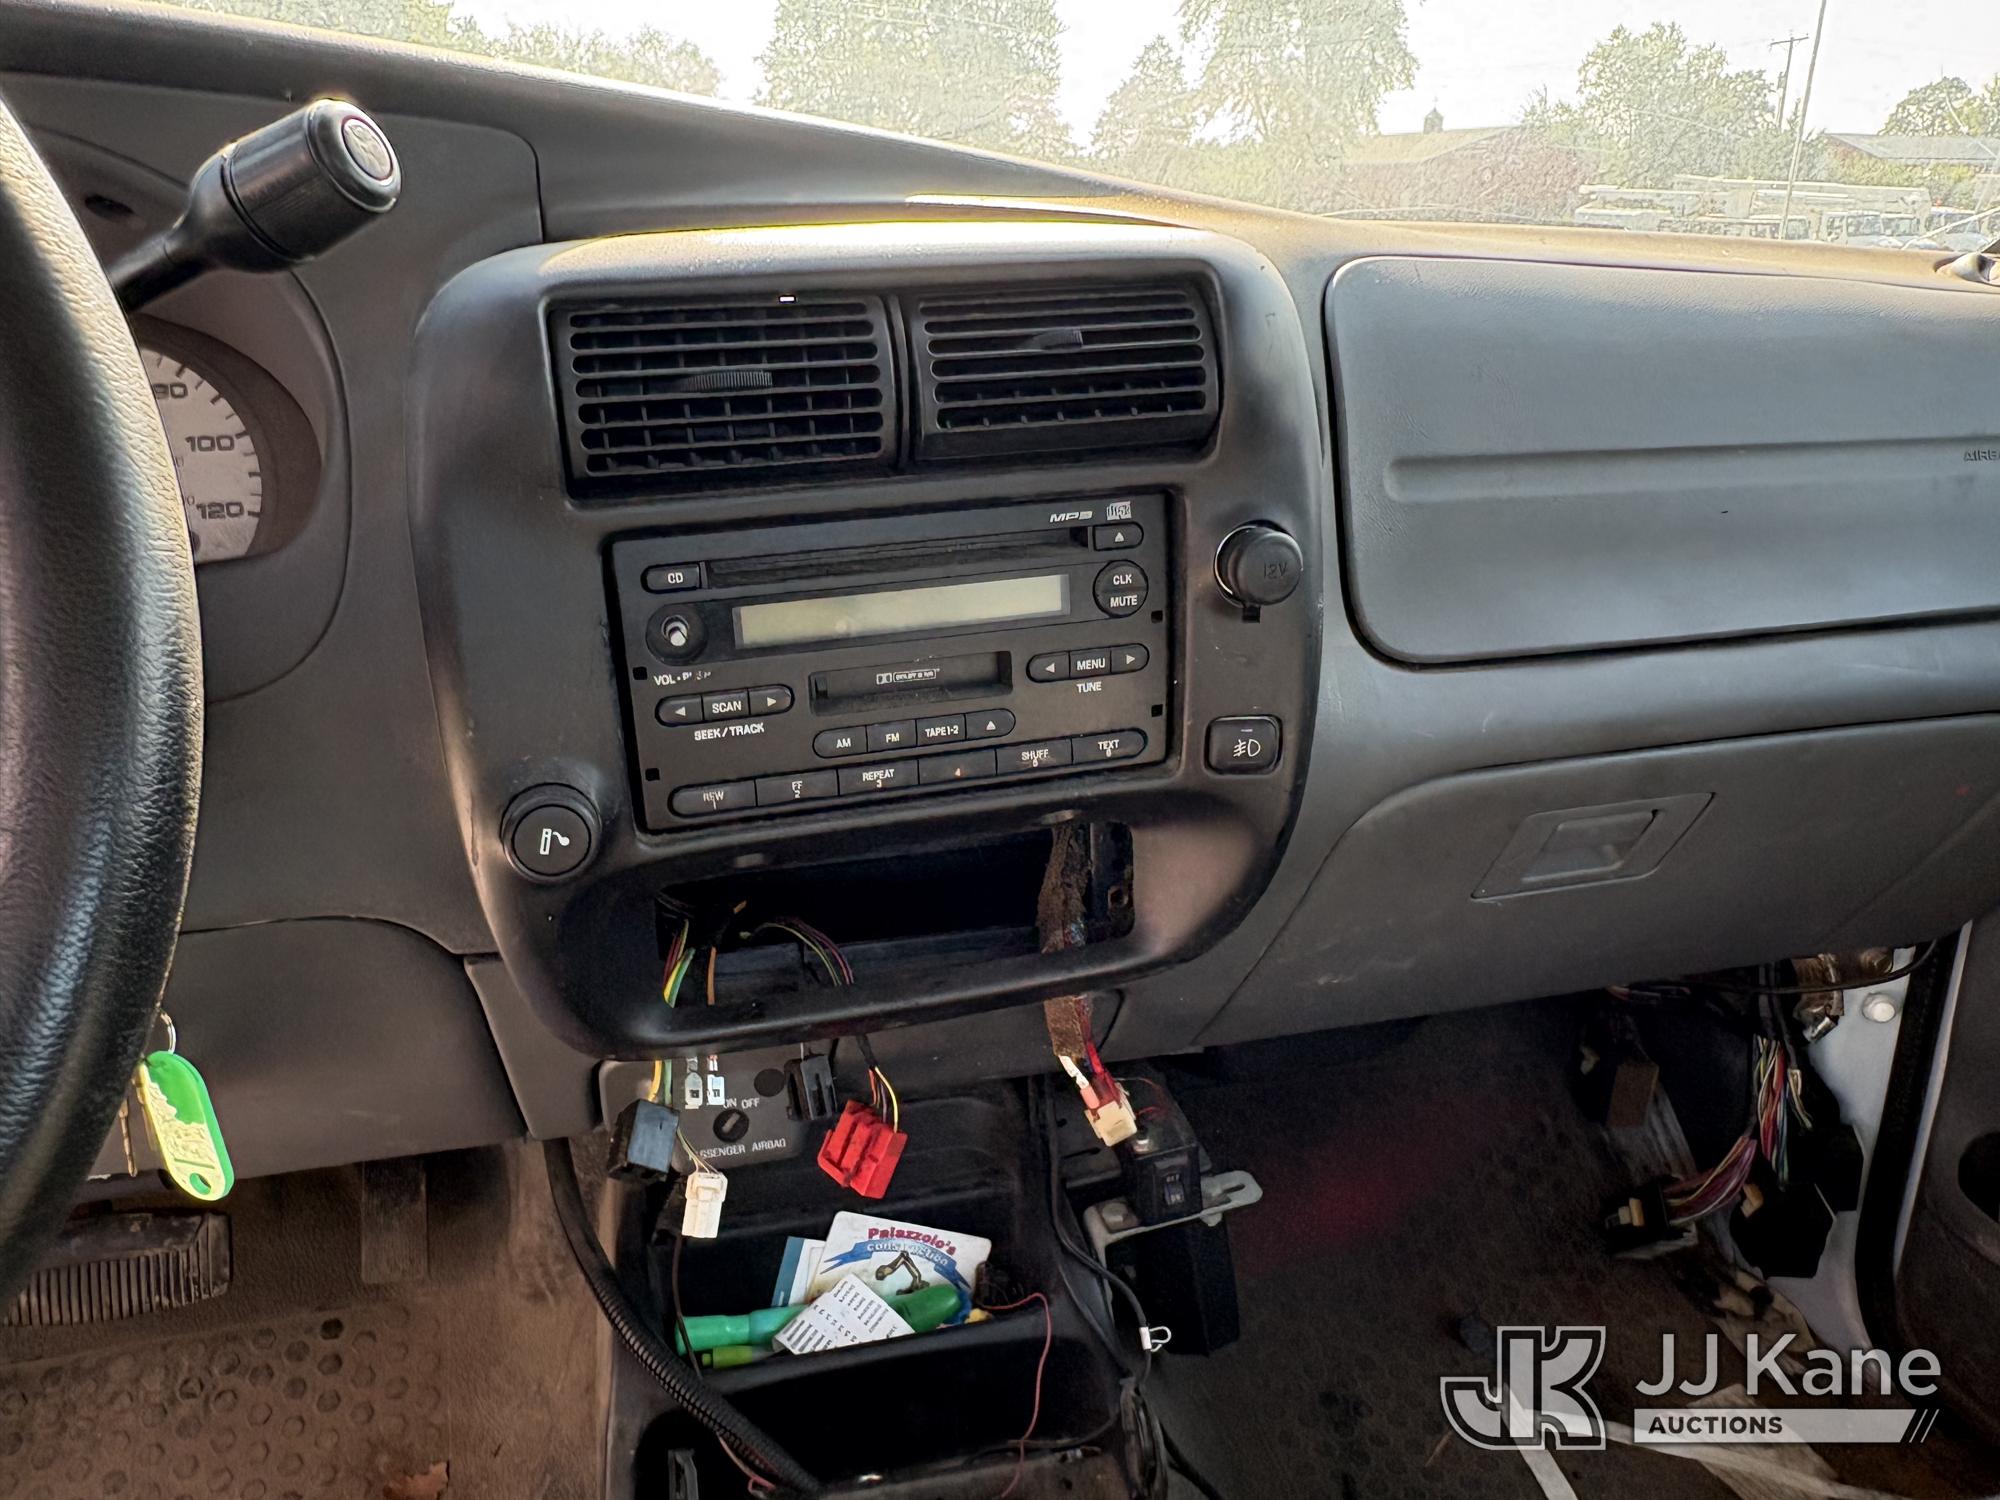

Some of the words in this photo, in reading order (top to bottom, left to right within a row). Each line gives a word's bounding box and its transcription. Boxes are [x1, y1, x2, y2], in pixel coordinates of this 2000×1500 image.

[185, 435, 235, 453] 100
[196, 501, 245, 520] 120
[667, 572, 684, 584] CD
[1113, 573, 1132, 586] CLK
[1110, 595, 1138, 608] MUTE
[1076, 658, 1106, 672] MENU
[1076, 681, 1102, 694] TUNE
[712, 700, 742, 714] SCAN
[836, 737, 851, 749] AM
[885, 732, 900, 743] FM
[1097, 739, 1120, 751] TEXT
[1021, 749, 1049, 762] SHUFF
[862, 768, 895, 782] REPEAT
[954, 767, 961, 777] 4
[794, 790, 801, 799] 2
[741, 1097, 760, 1110] OFF
[868, 1226, 957, 1256] Palazzolo's
